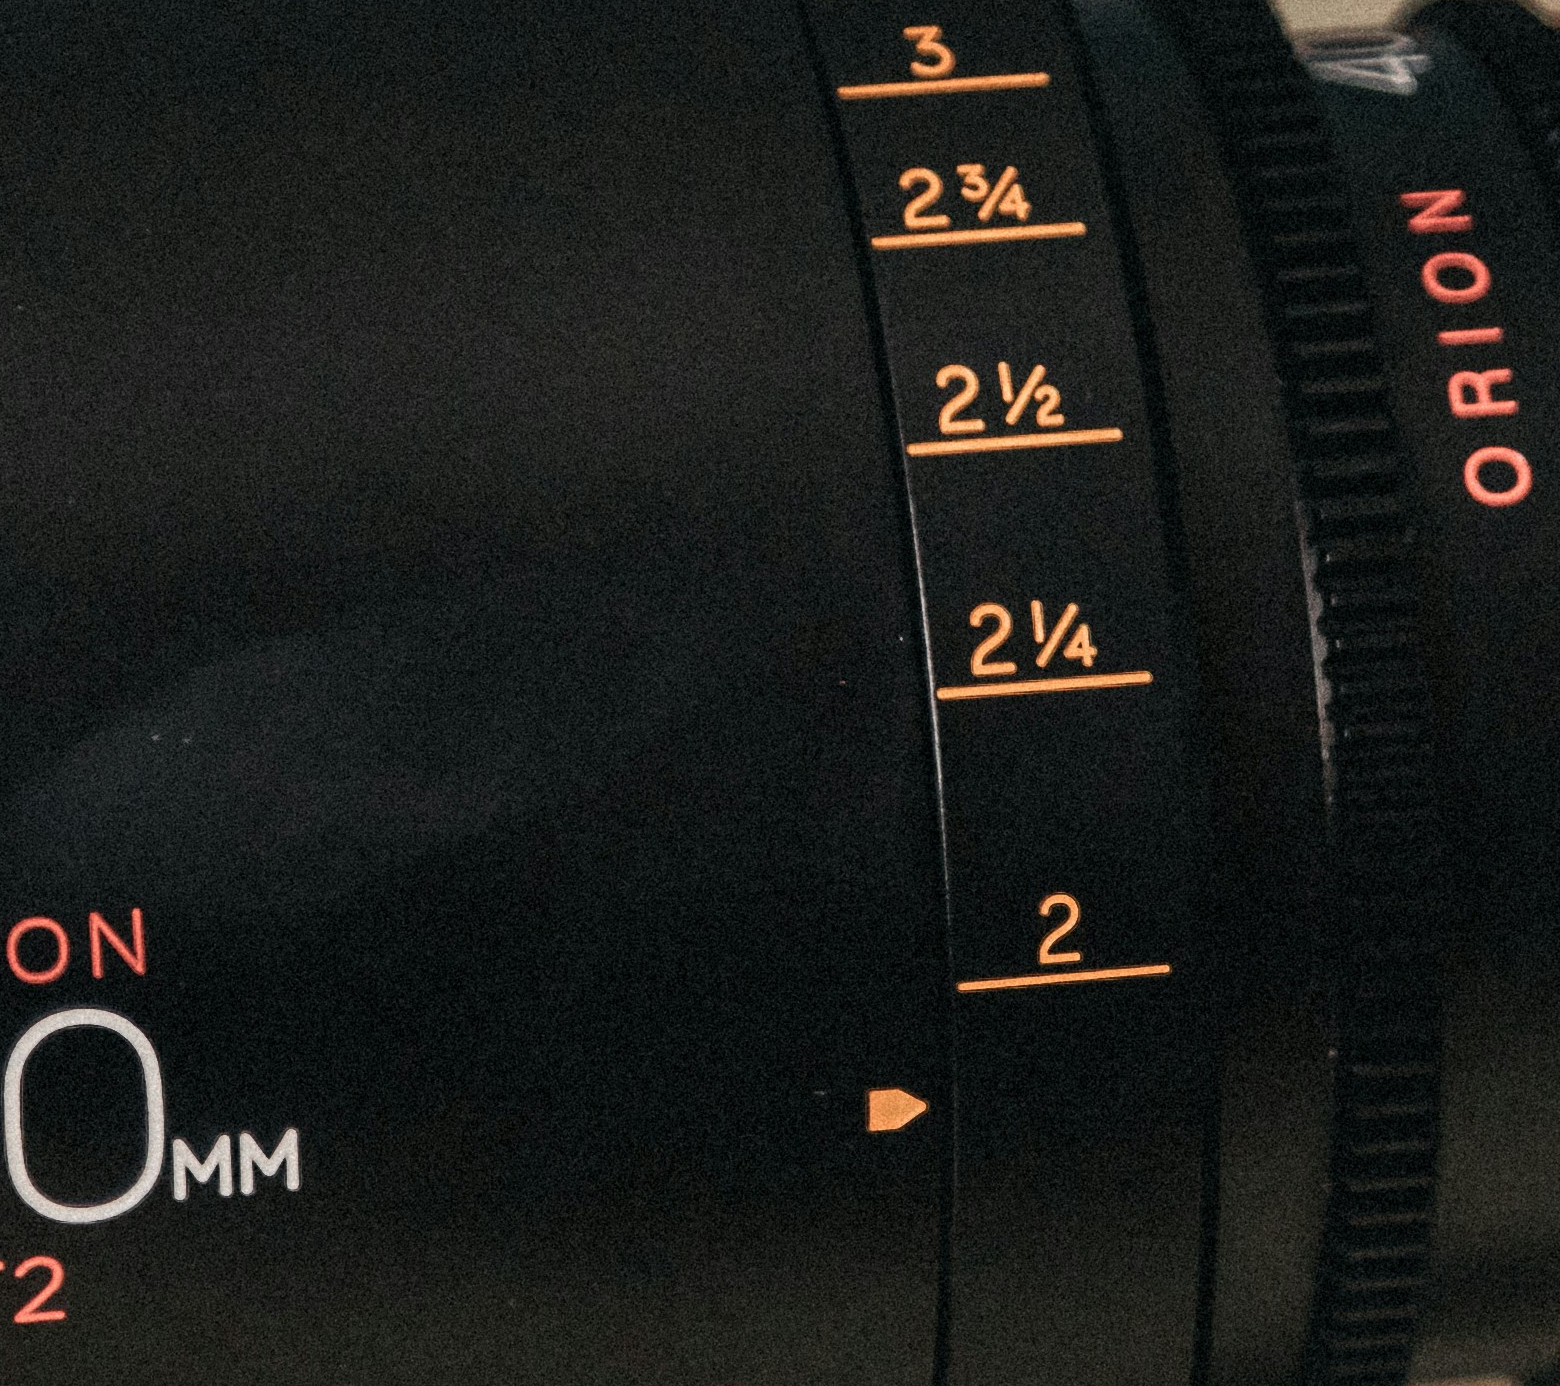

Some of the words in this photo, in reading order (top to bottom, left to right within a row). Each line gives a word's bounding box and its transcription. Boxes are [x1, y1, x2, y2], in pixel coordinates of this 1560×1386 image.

[903, 24, 957, 78] 3
[1398, 189, 1533, 508] ORION
[1039, 891, 1082, 965] 2
